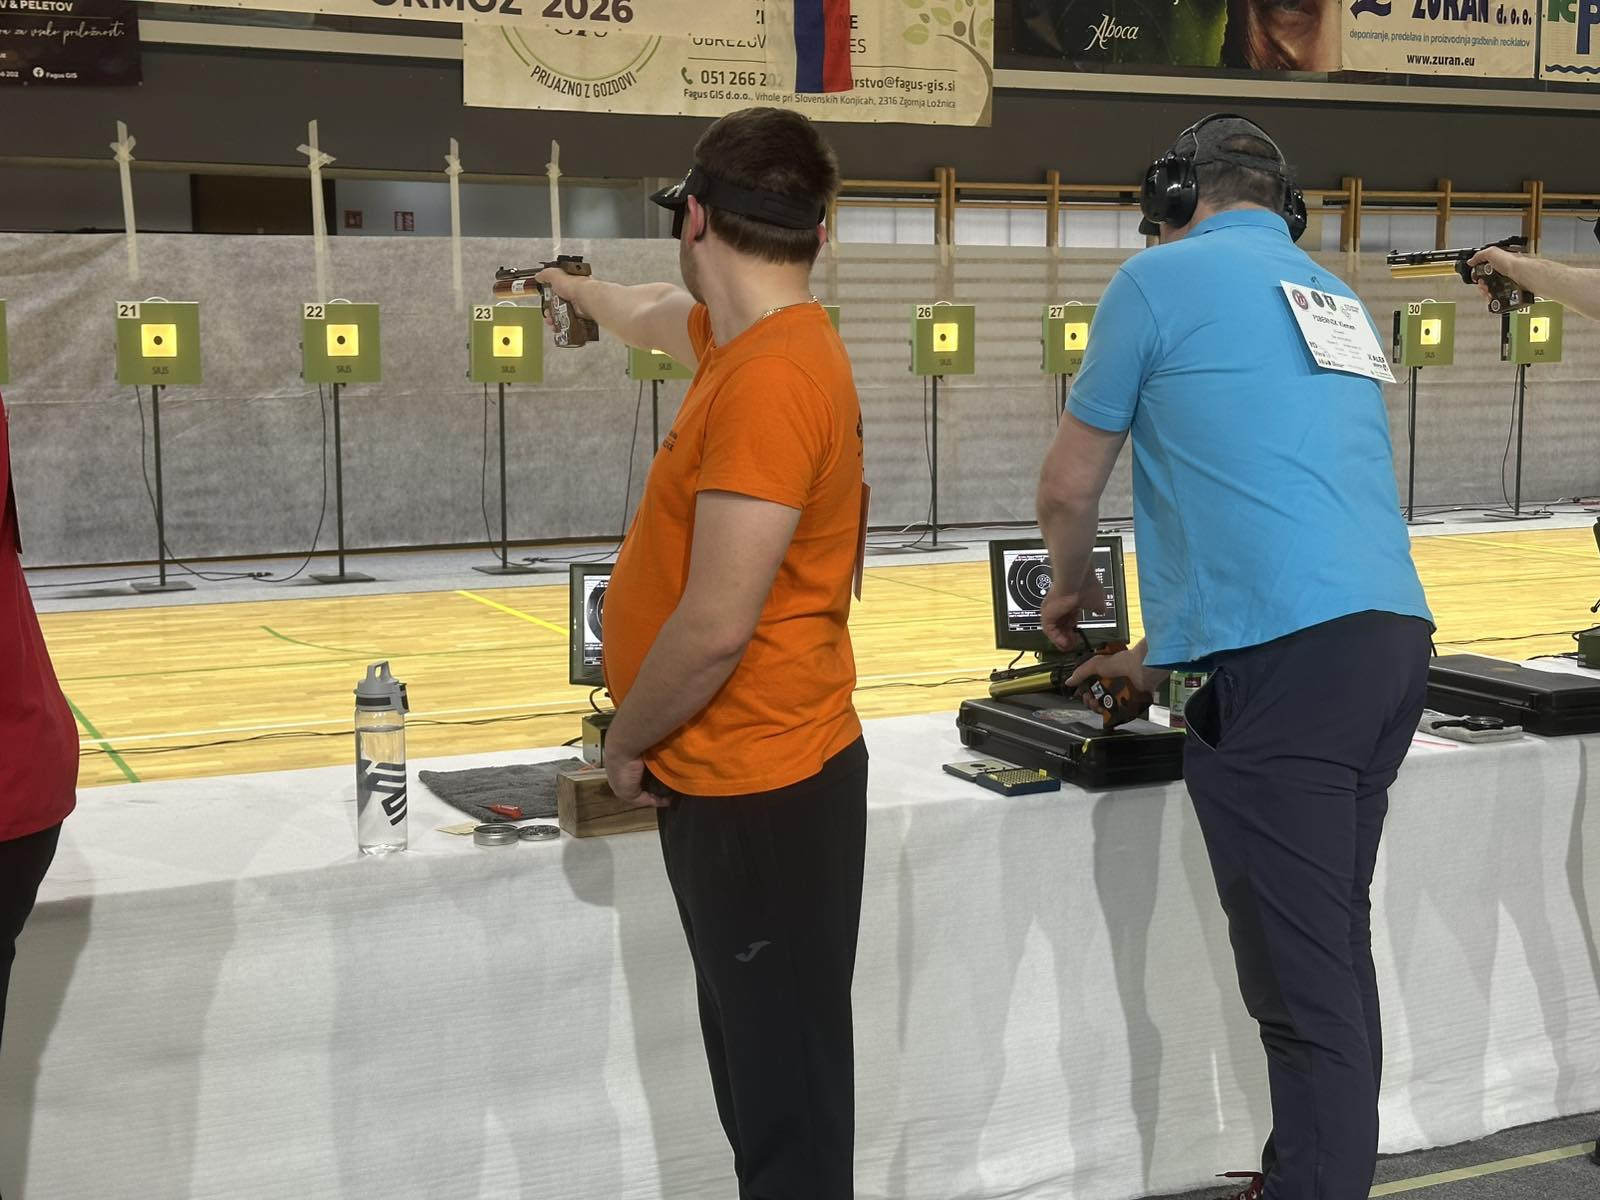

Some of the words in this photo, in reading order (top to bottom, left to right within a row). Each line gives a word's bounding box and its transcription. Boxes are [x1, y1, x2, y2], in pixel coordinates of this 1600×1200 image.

[9, 0, 18, 9] &
[20, 0, 74, 12] PELETOV
[541, 0, 634, 24] 2026
[1083, 13, 1140, 51] Aboca
[1406, 53, 1476, 67] www.zuran.eu
[530, 65, 583, 98] PRIJAZNO
[583, 83, 591, 99] Z
[592, 70, 638, 98] GOZDOVI
[701, 70, 725, 85] 051
[729, 71, 756, 87] 266
[683, 88, 708, 101] Fagus
[709, 90, 724, 100] GIS
[782, 93, 793, 104] pri
[795, 93, 839, 105] Slovenskih
[840, 95, 877, 107] Konjicah,
[878, 96, 898, 106] 2316
[119, 304, 137, 317] 21
[306, 305, 323, 318] 22
[475, 307, 491, 320] 23
[918, 307, 932, 318] 26
[1050, 307, 1063, 318] 27
[1409, 304, 1421, 315] 30
